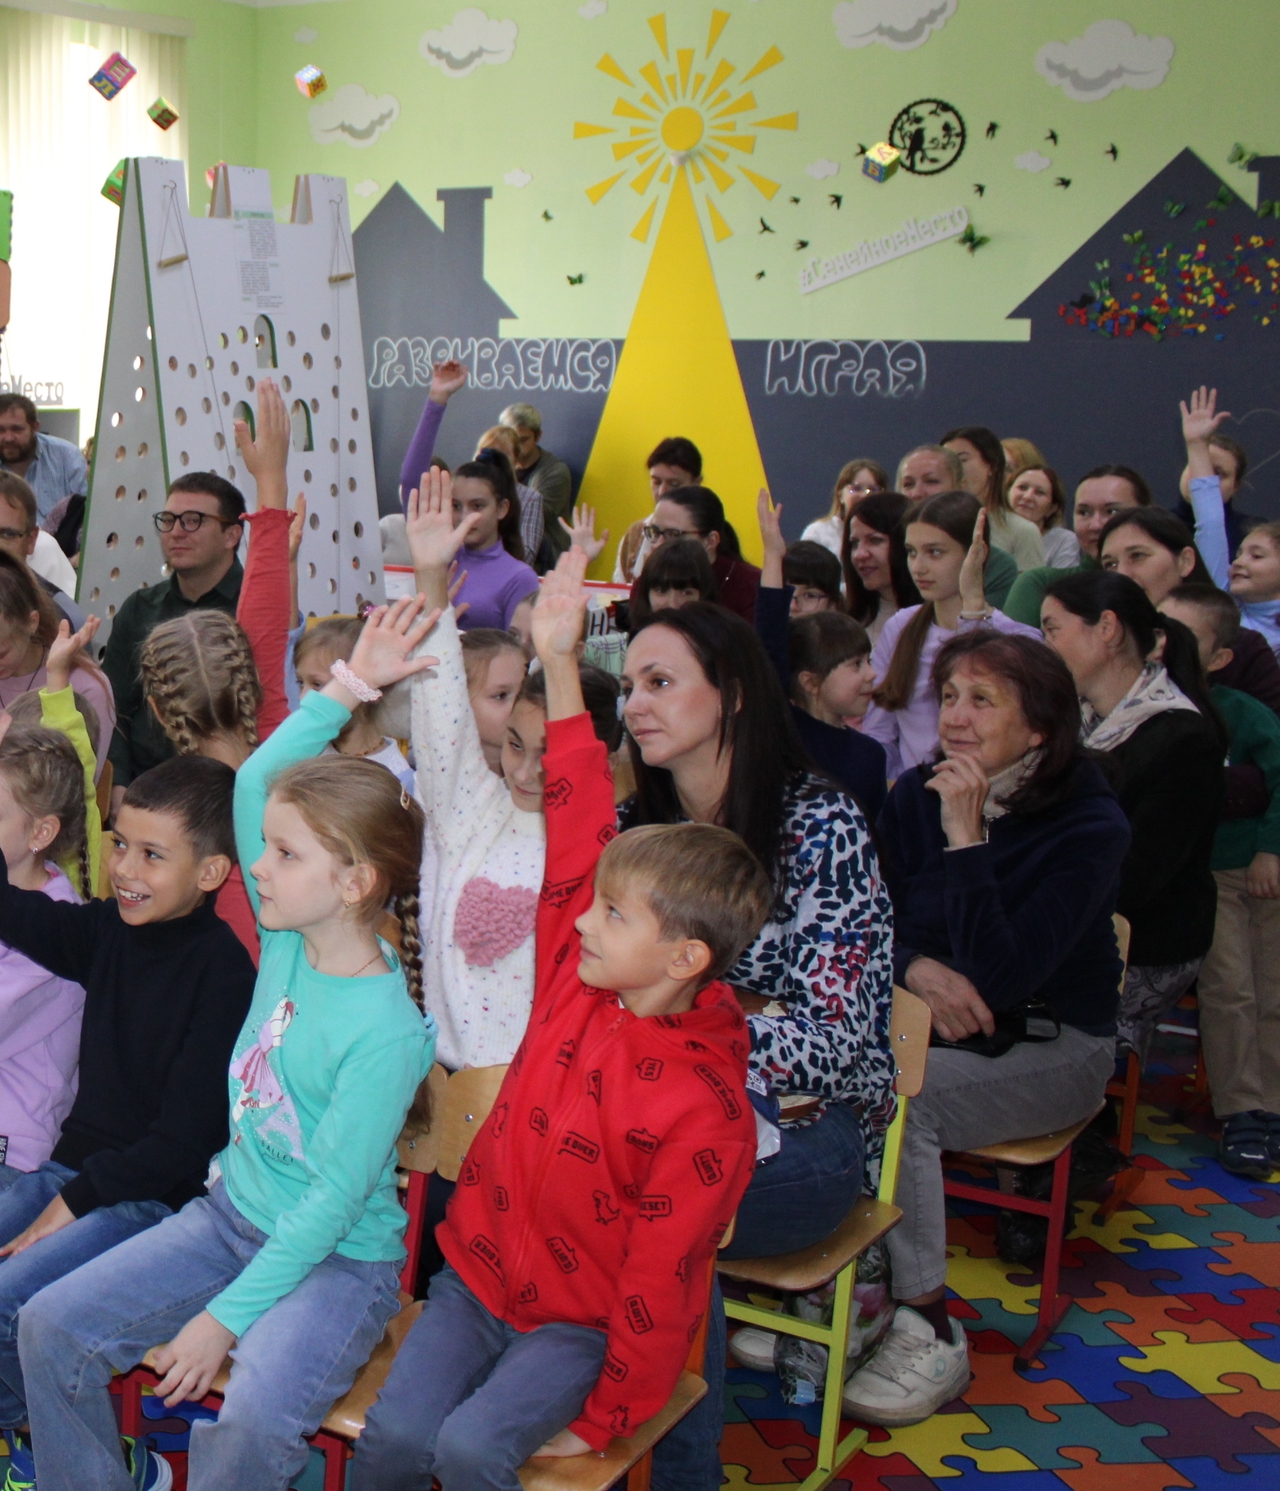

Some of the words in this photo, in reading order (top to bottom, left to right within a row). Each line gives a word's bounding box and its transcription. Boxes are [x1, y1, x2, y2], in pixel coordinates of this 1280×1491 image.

[800, 206, 969, 295] #СемейноеМесто
[765, 338, 927, 398] ИГРАЯ
[629, 1300, 648, 1331] QUIT?
